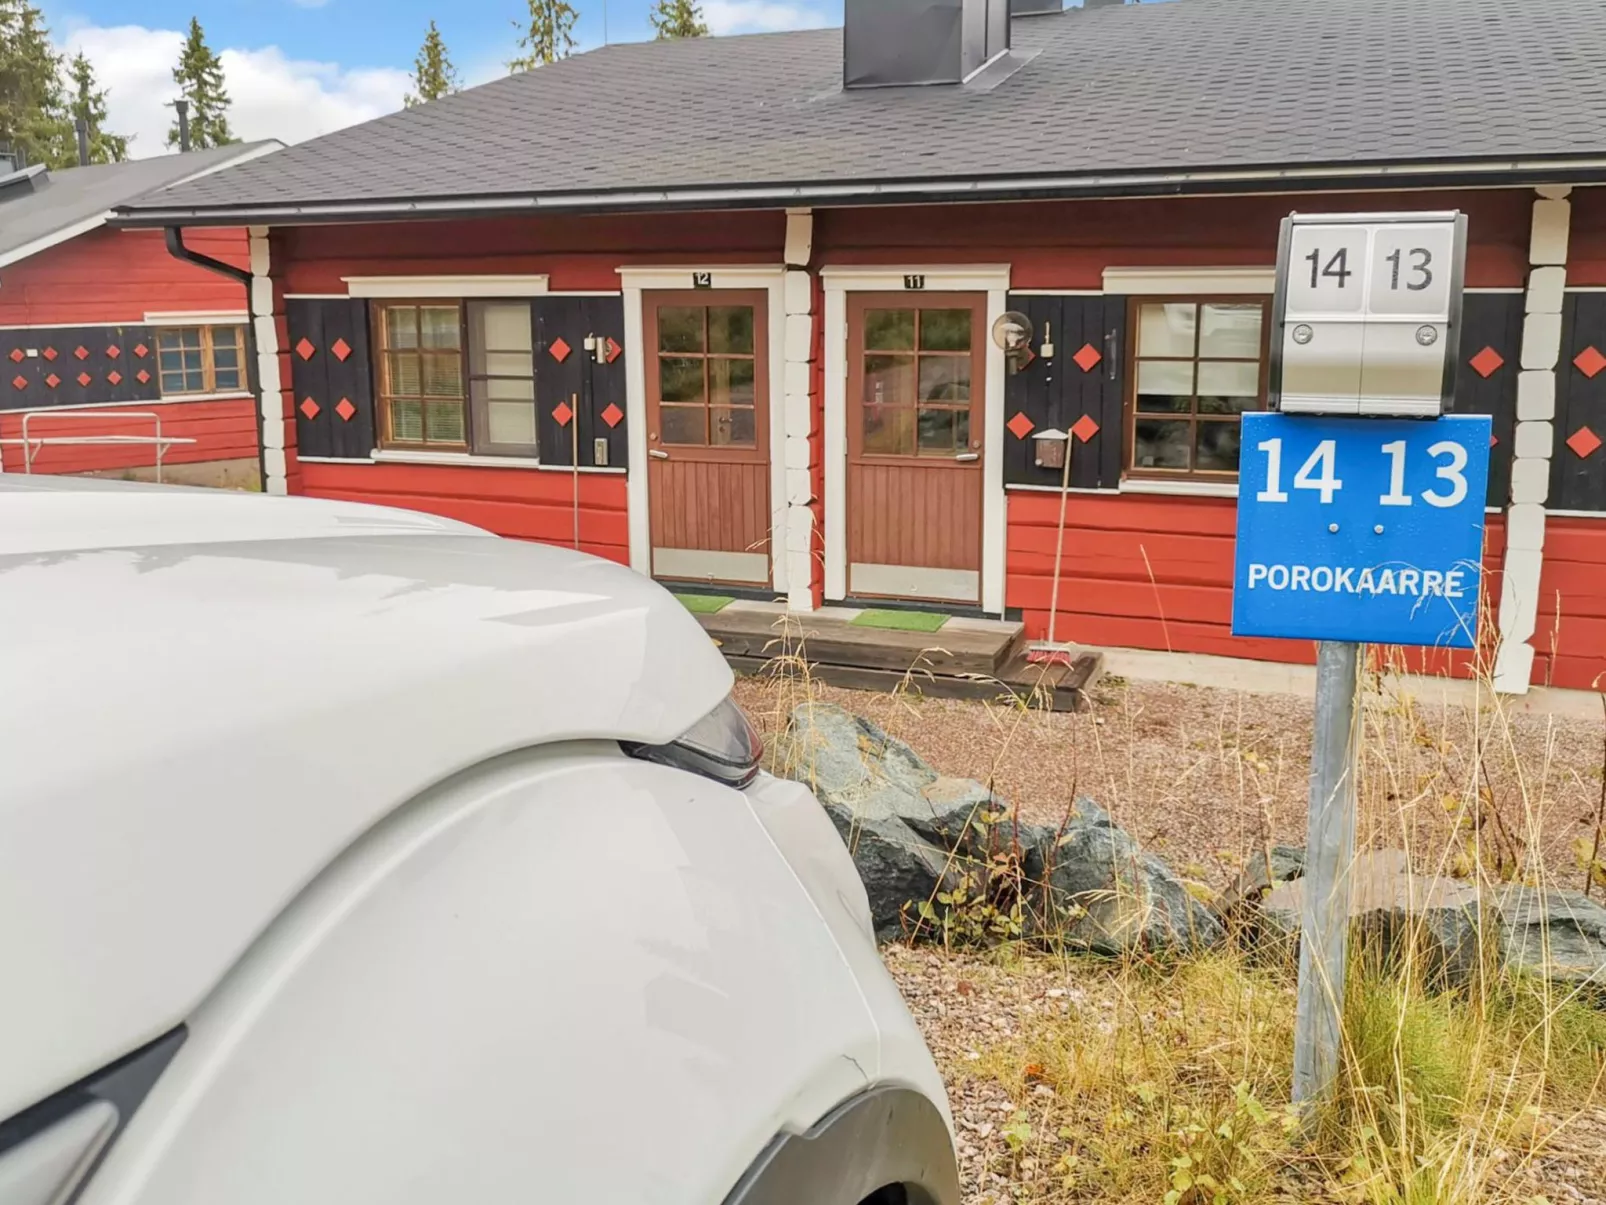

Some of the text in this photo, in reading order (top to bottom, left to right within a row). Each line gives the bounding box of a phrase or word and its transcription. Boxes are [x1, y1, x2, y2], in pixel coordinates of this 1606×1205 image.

[695, 271, 709, 285] 12
[907, 275, 921, 288] 11
[1304, 247, 1352, 289] 14
[1385, 247, 1433, 291] 13
[1256, 437, 1468, 508] 14 13
[1247, 563, 1465, 598] POROKAARRE
